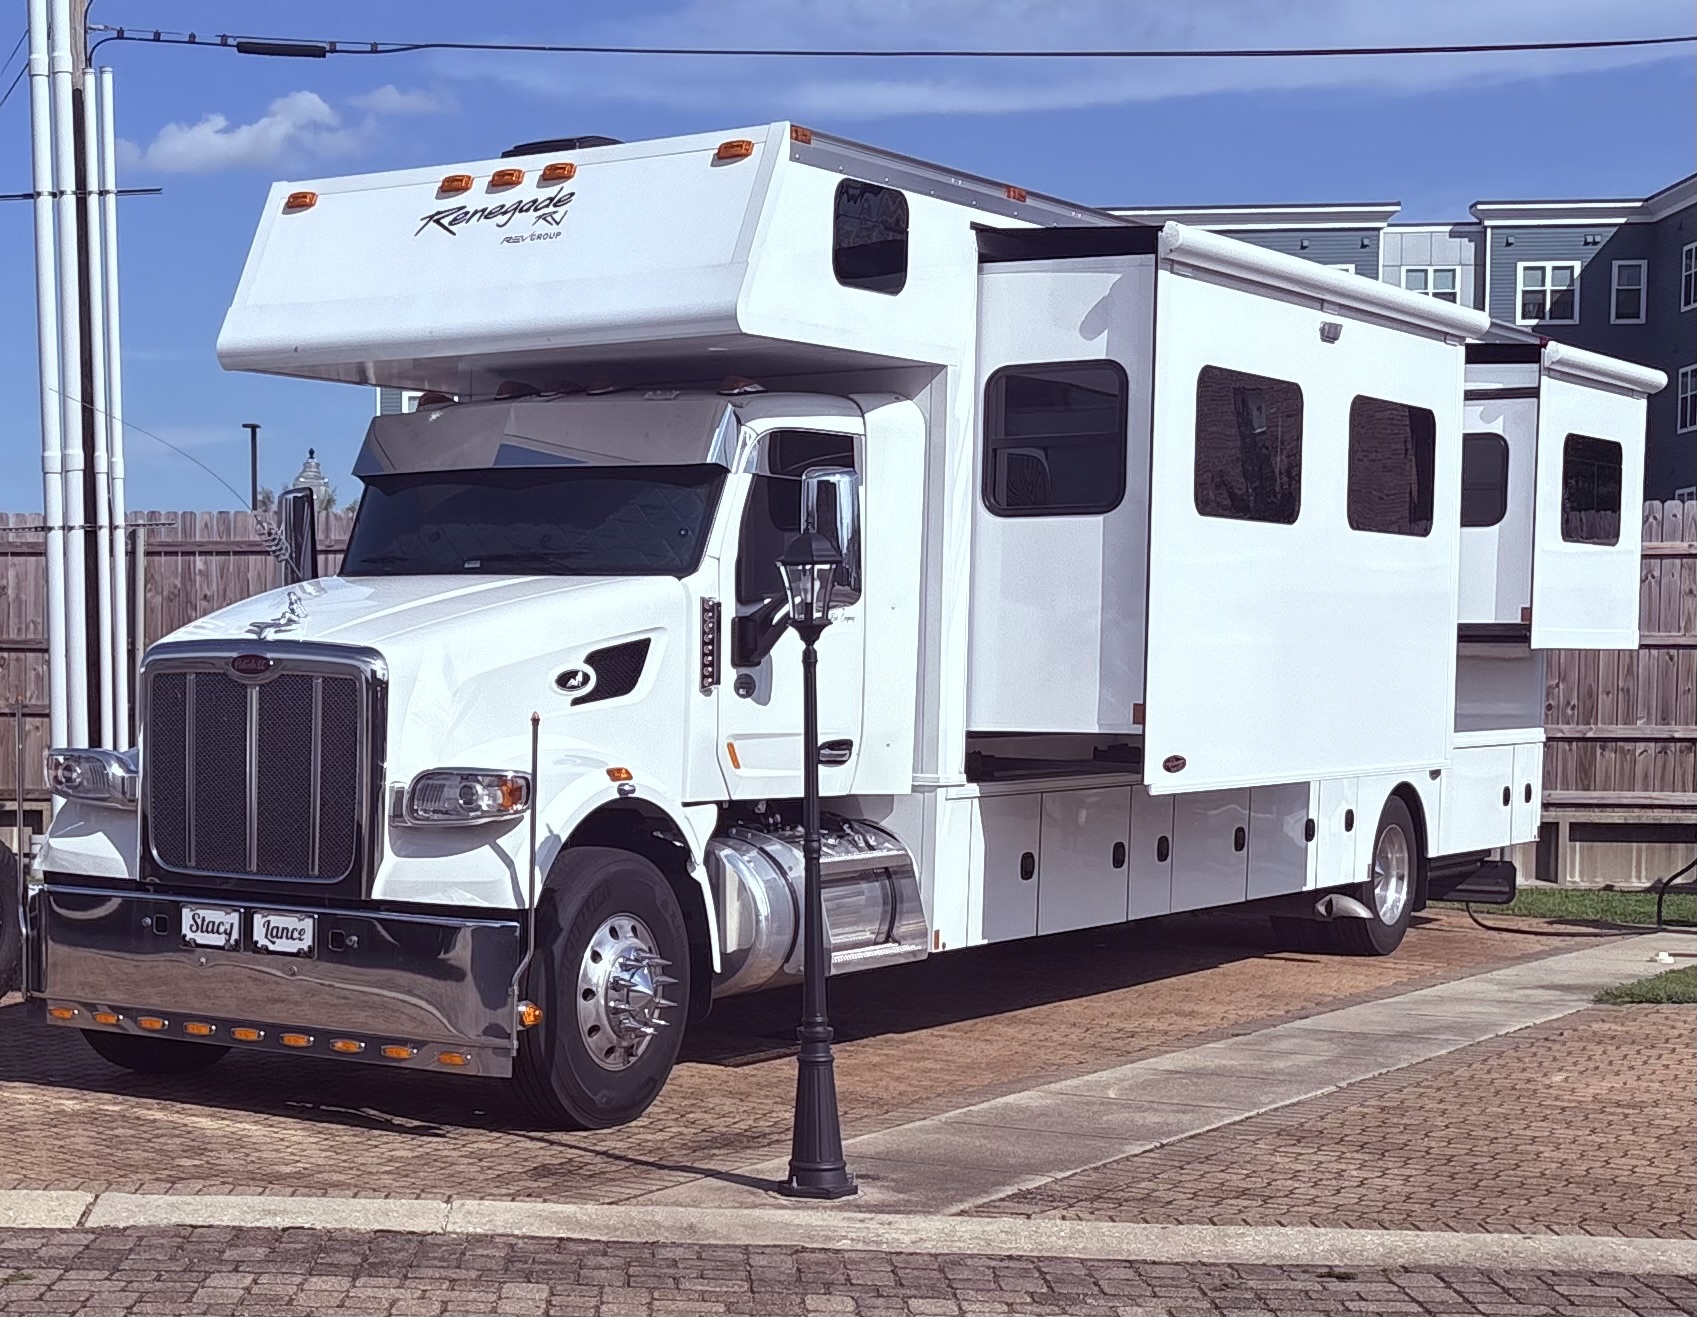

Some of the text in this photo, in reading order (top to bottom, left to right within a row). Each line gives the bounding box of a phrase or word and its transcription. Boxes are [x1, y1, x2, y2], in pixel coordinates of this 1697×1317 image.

[414, 186, 576, 236] Renegade
[532, 210, 568, 226] RV
[189, 912, 234, 942] Stacy
[262, 919, 306, 945] Lance
